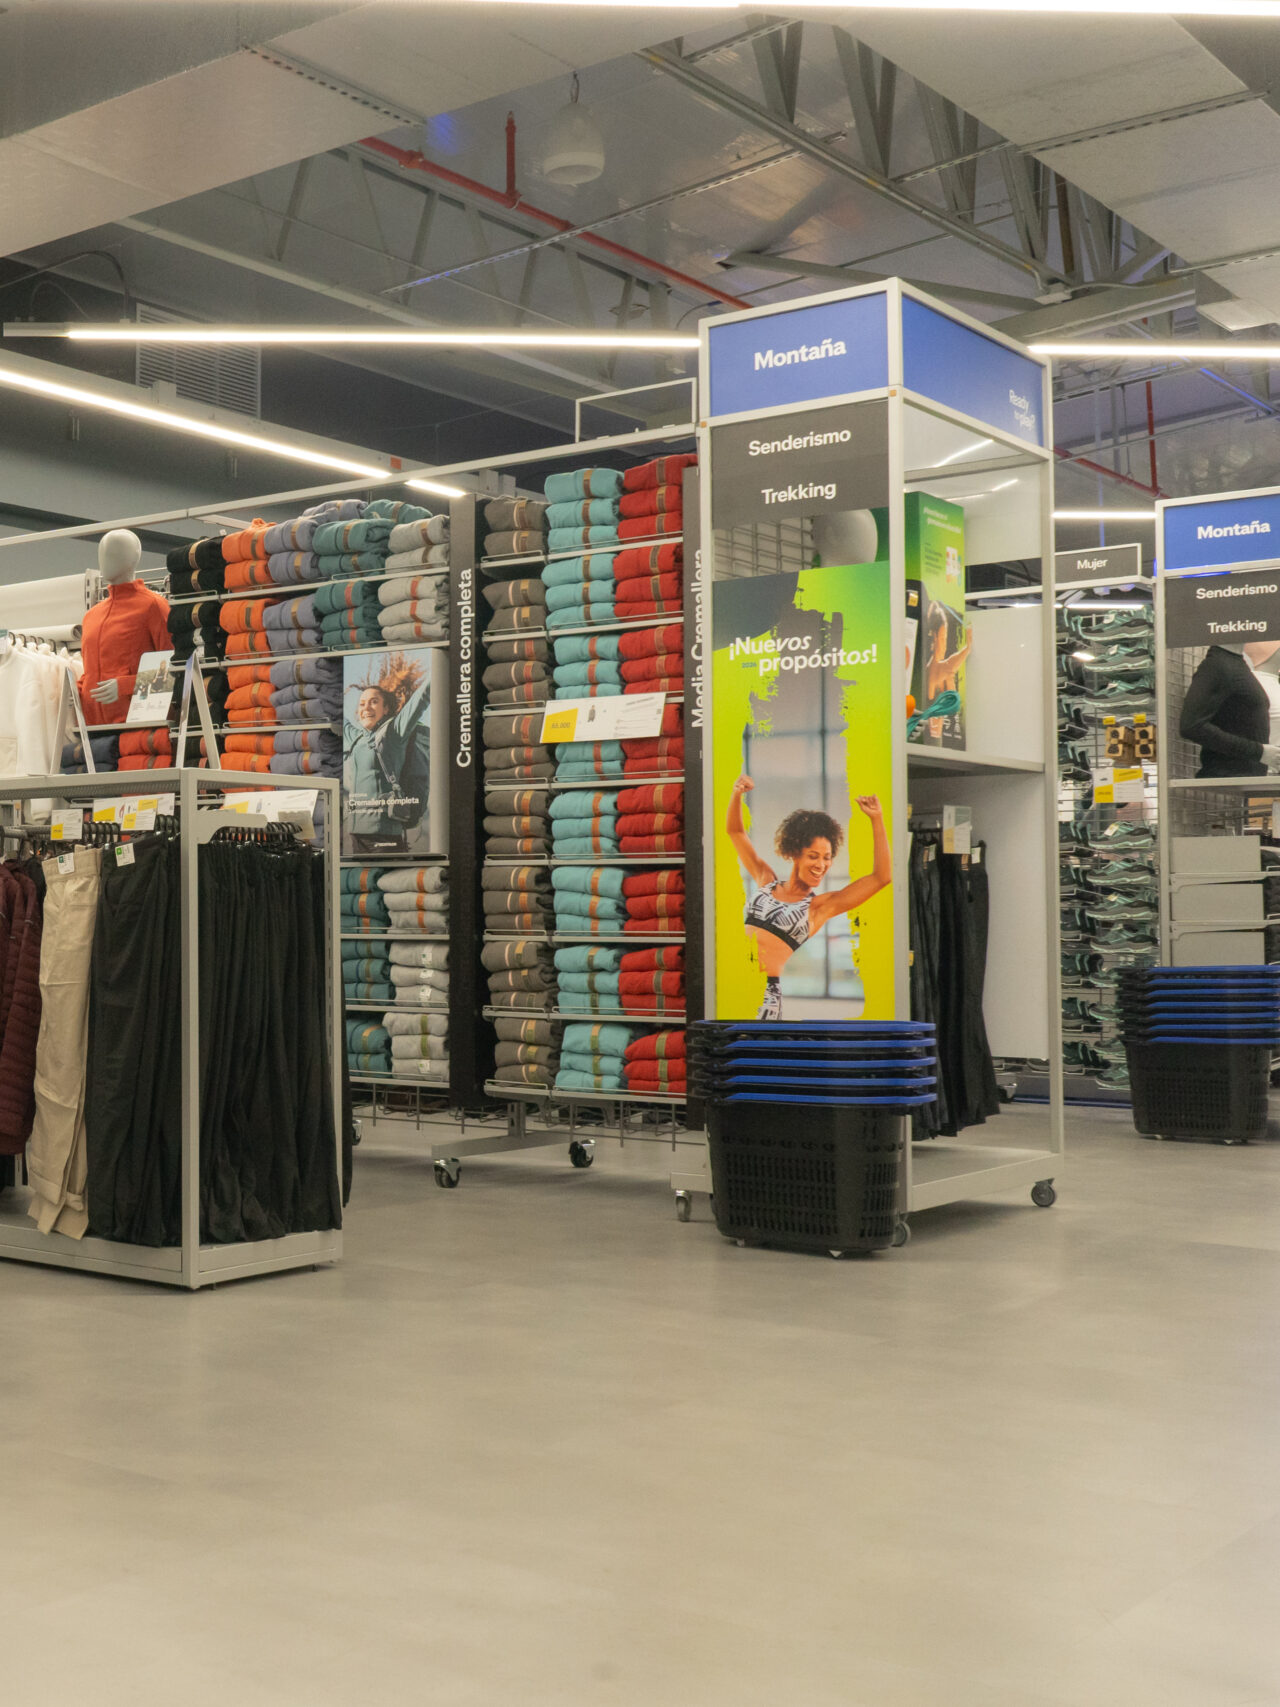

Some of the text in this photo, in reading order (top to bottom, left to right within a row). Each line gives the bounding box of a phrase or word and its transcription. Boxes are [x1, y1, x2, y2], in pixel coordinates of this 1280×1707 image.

[754, 338, 847, 370] Montaña
[1009, 389, 1029, 415] Ready
[748, 429, 852, 456] Senderismo
[761, 482, 837, 505] Trekking
[1197, 520, 1271, 539] Montaña
[1077, 558, 1108, 570] Mujer
[1195, 584, 1278, 600] Senderismo
[691, 549, 704, 728] Media Cremallera
[1207, 619, 1268, 634] Trekking
[729, 635, 812, 661] ¡Nuevos
[759, 643, 878, 677] propósitos!
[456, 568, 475, 769] Cremallera completa
[349, 797, 419, 807] Cremallera completa
